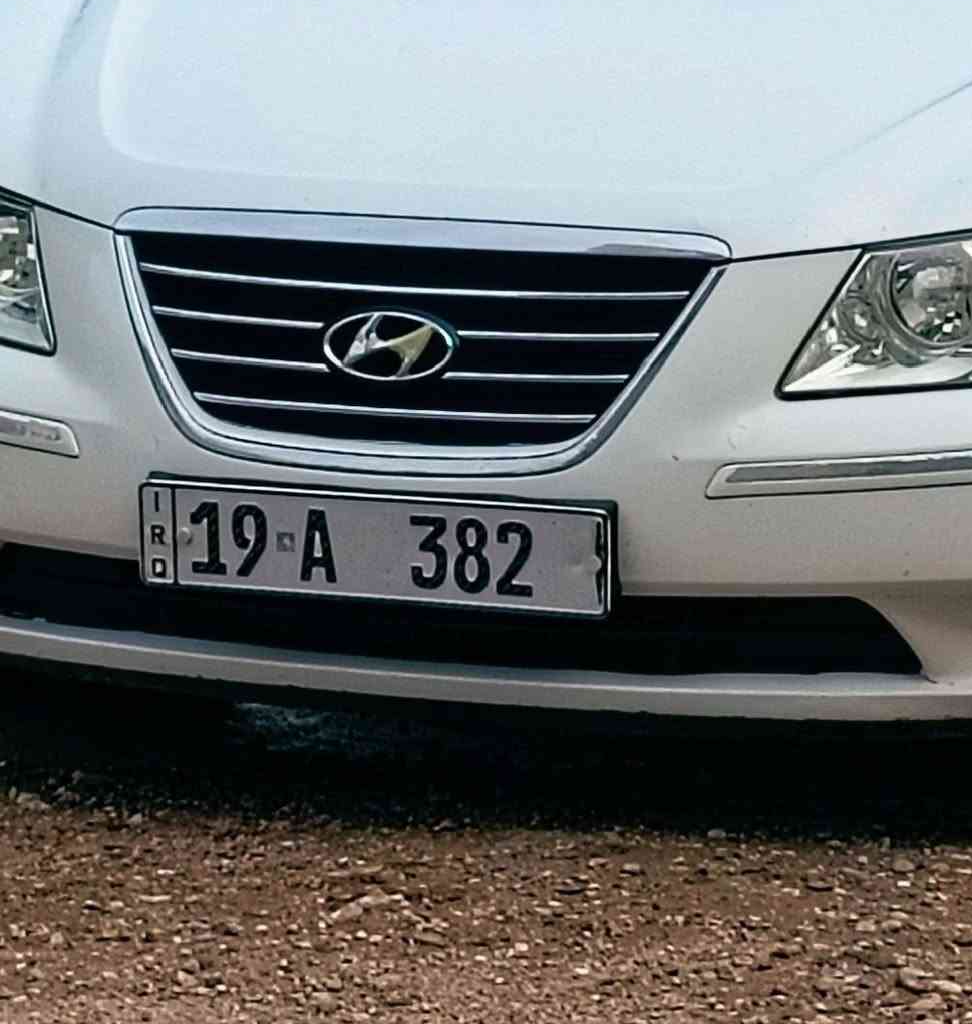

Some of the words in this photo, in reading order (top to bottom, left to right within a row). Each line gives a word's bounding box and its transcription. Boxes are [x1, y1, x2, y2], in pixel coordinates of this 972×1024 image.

[190, 501, 268, 577] 19
[300, 508, 338, 584] A
[408, 514, 534, 598] 382
